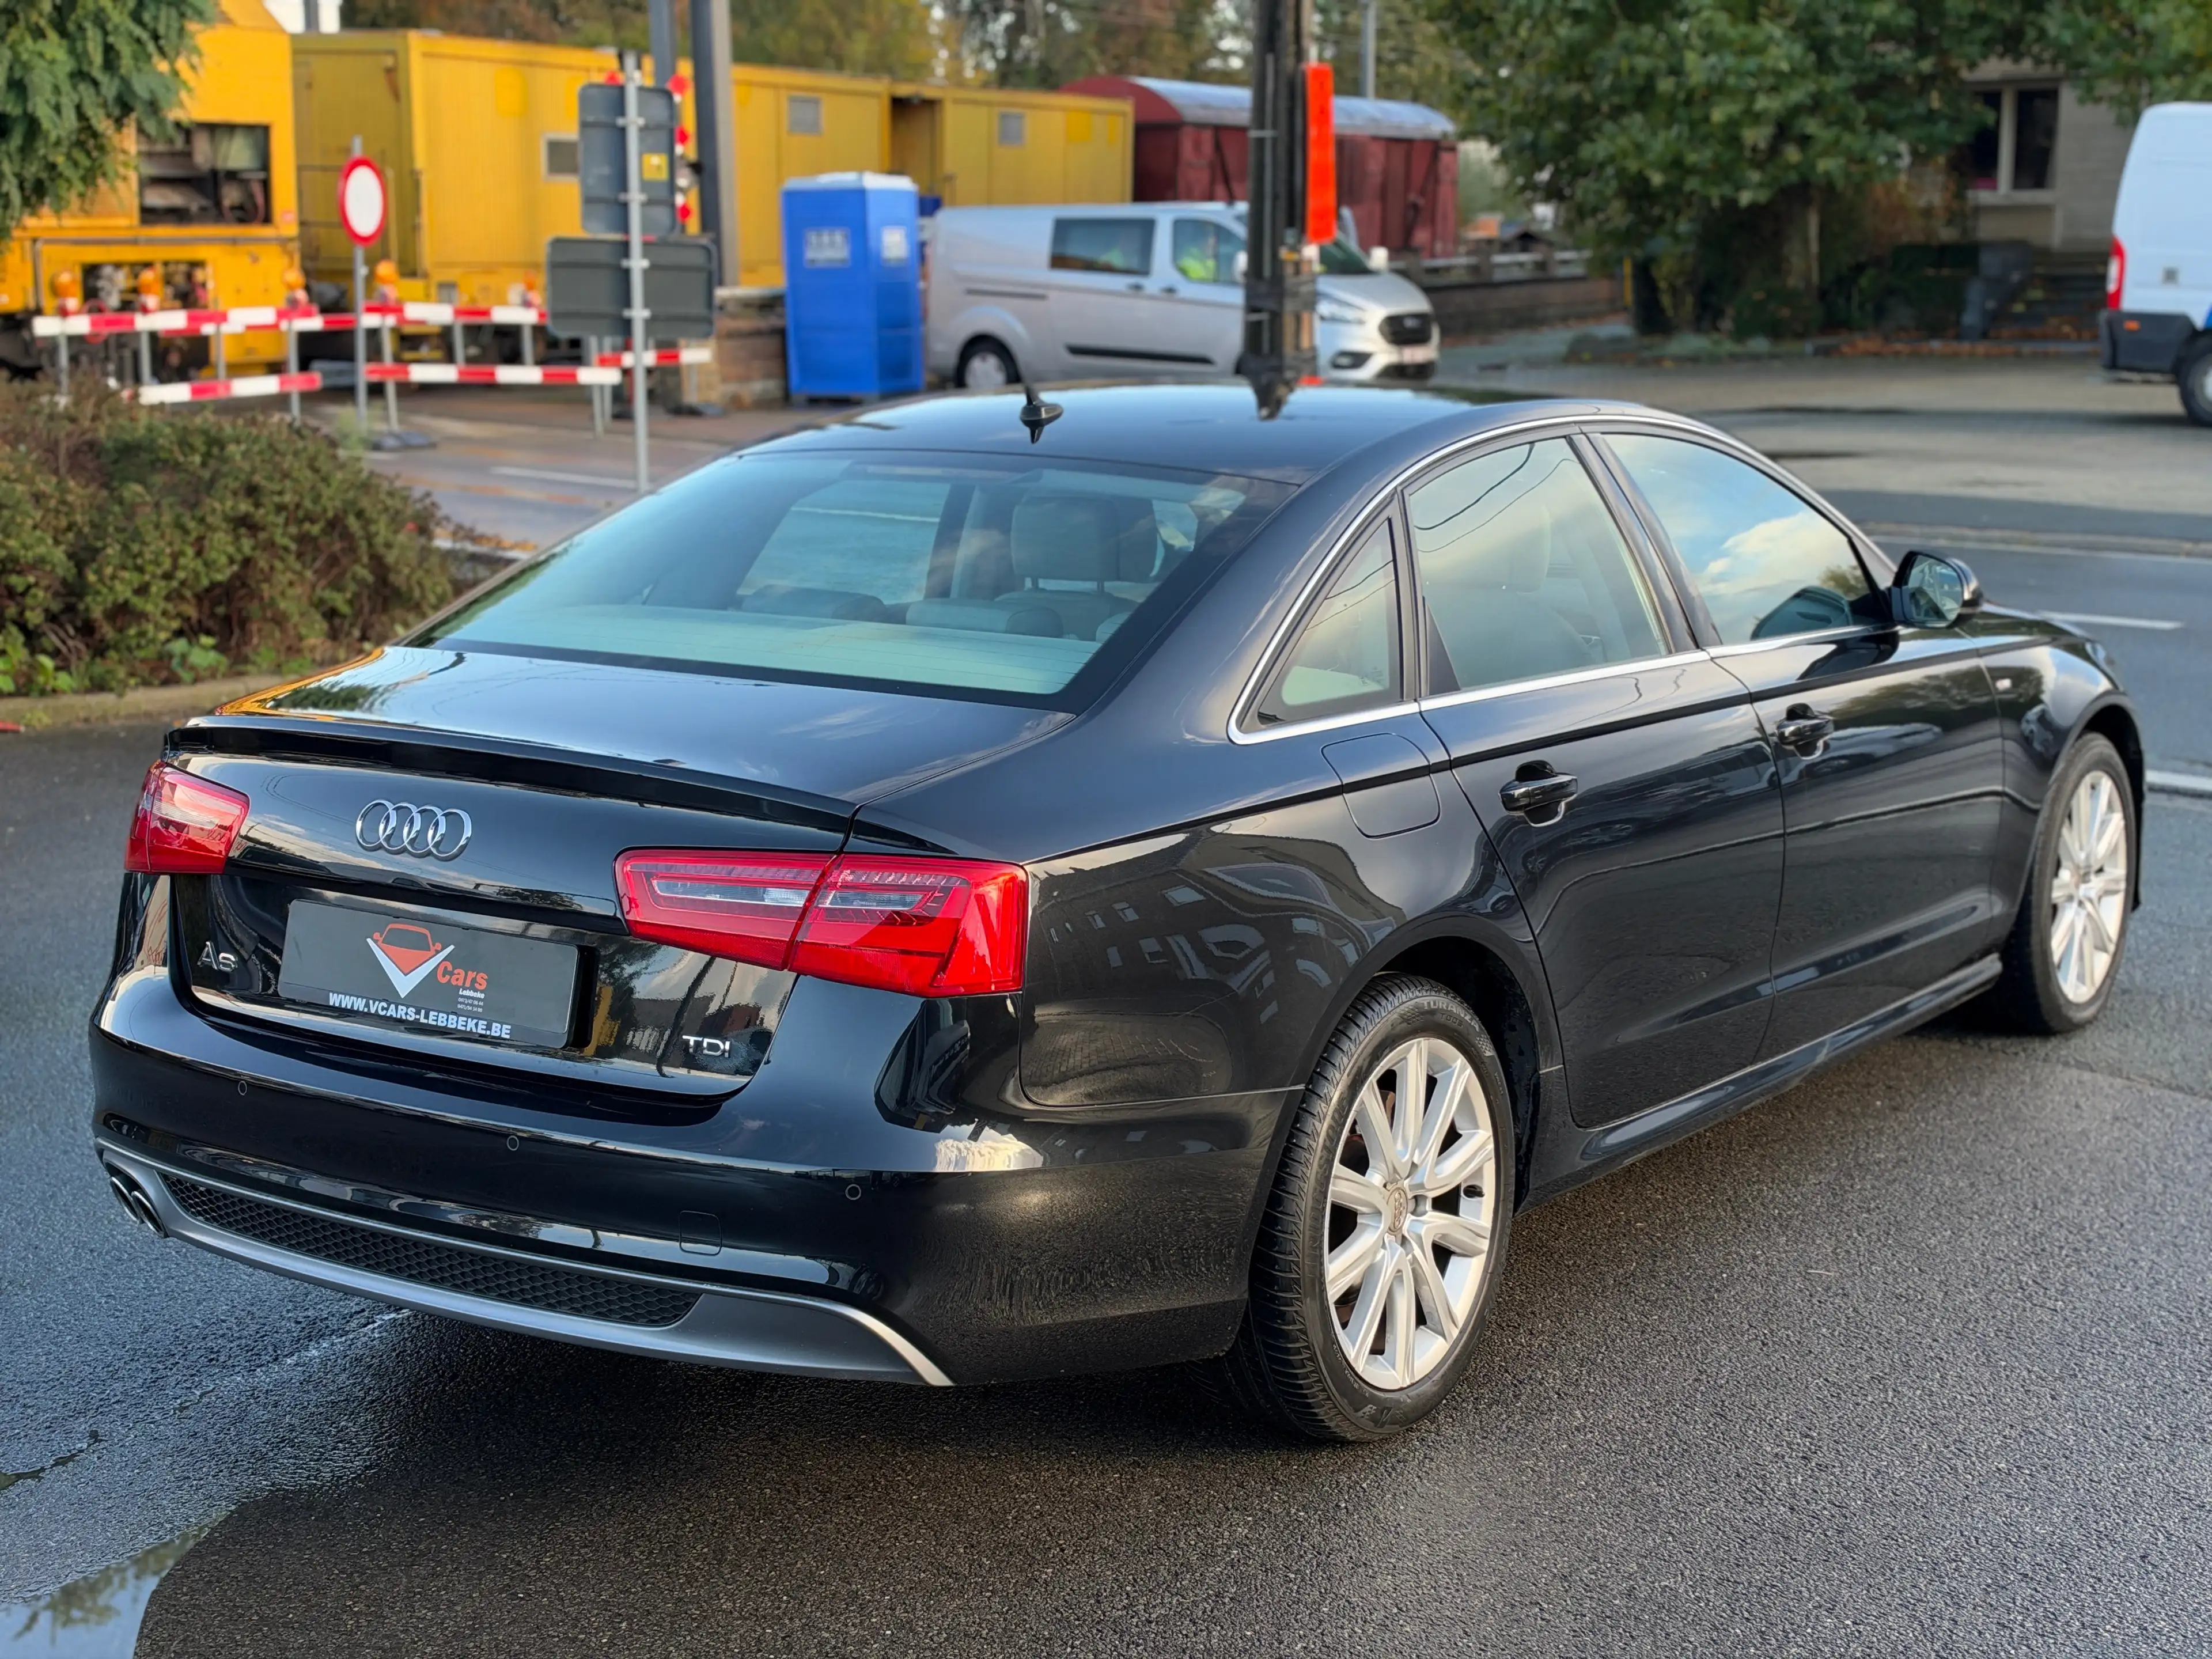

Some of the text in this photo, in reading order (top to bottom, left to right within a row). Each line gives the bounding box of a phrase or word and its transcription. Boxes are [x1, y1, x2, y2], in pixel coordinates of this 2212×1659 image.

[196, 941, 238, 972] A6
[437, 961, 488, 990] Cars
[459, 988, 485, 999] Lebbeke
[329, 992, 512, 1039] WWW.VCARS-LEBBEKE.BE
[1421, 999, 1479, 1032] TURANZA
[1440, 1013, 1464, 1028] T005
[682, 1035, 730, 1058] TDI
